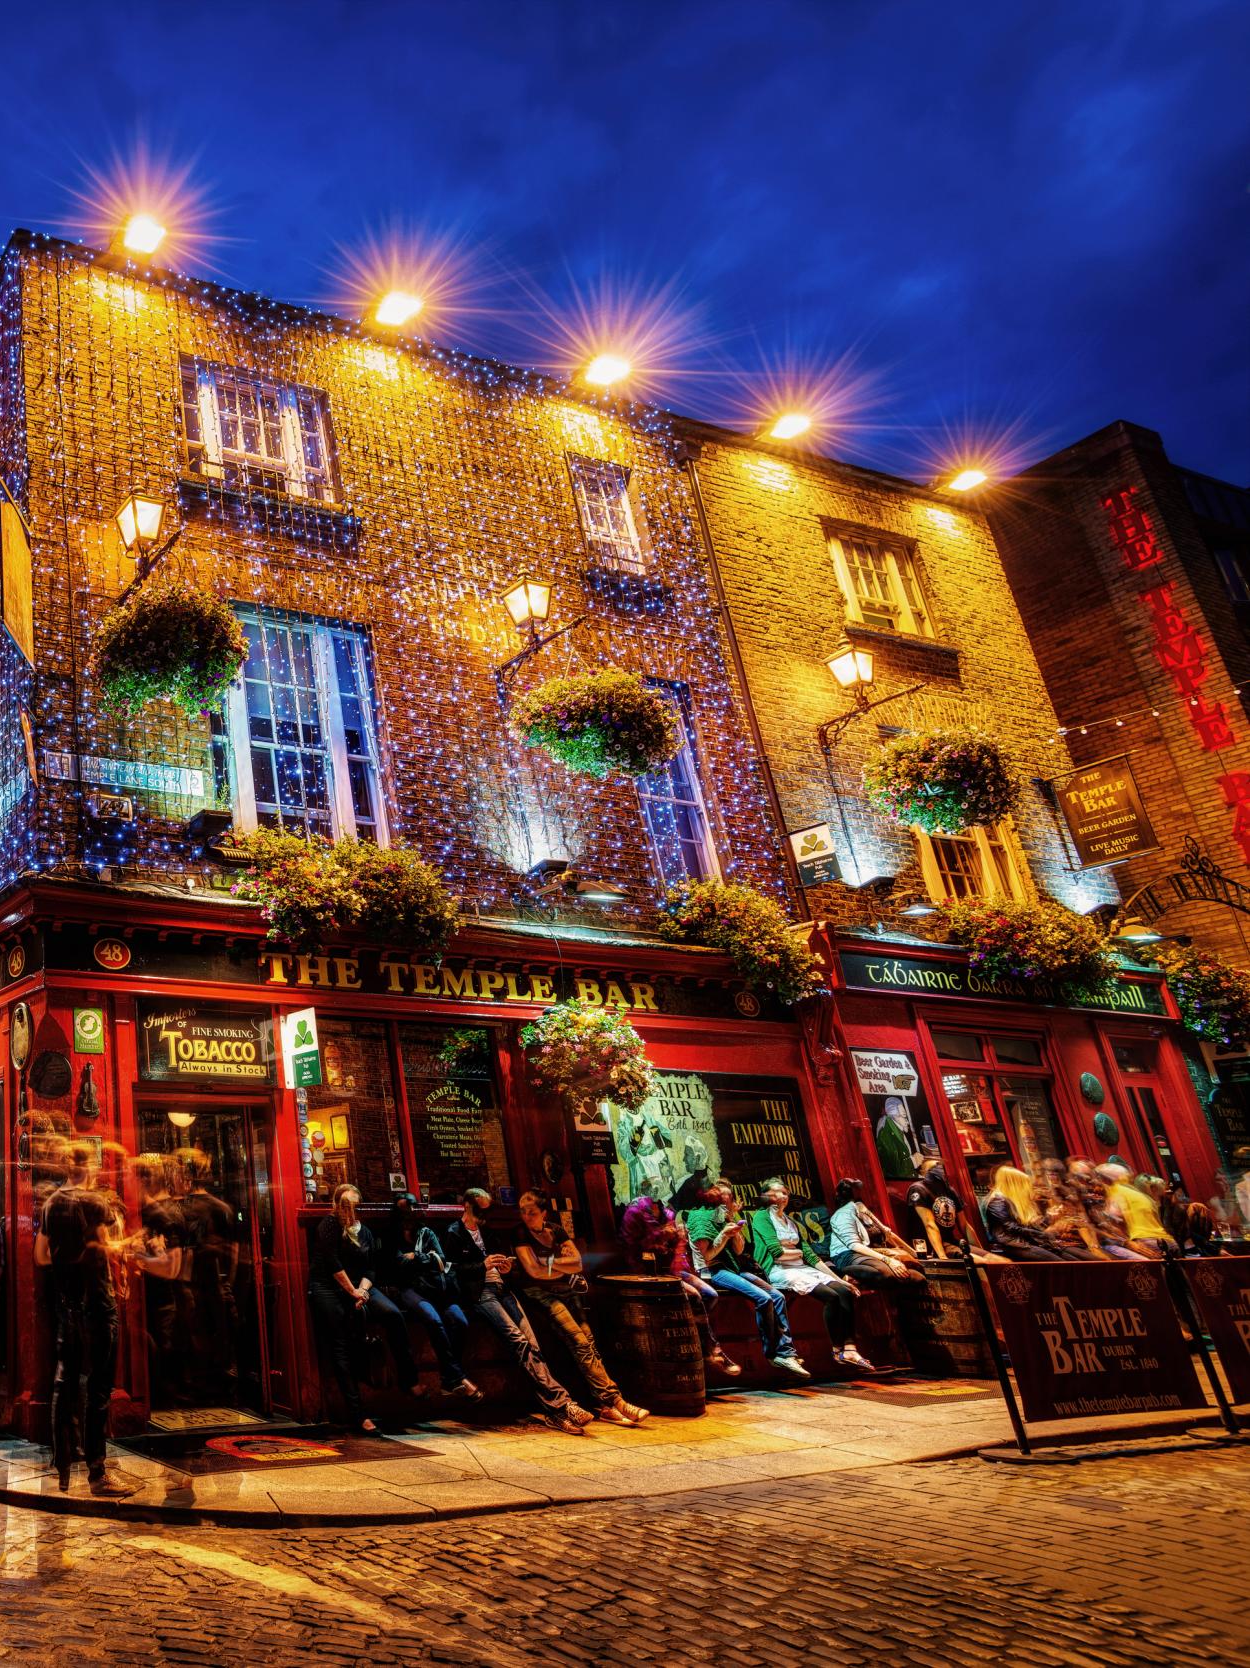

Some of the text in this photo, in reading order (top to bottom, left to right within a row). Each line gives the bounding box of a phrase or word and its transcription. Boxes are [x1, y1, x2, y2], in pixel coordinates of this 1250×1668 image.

[119, 774, 144, 787] LANE
[1080, 771, 1101, 784] THE
[1066, 780, 1126, 805] TEMPLE
[1083, 796, 1118, 813] BAR
[1078, 813, 1137, 835] BEER GARDEN
[1090, 834, 1139, 852] LIVE MUSIC
[1104, 844, 1129, 855] DAILY
[10, 951, 22, 972] 48
[100, 943, 124, 962] 48
[261, 952, 660, 1010] THE TEMPLE BAR
[143, 1008, 197, 1030] Importers
[192, 1027, 254, 1038] FINE SMOKING
[159, 1030, 256, 1068] TOBACCO
[181, 1062, 265, 1075] Always in Stock
[854, 1054, 873, 1067] Beer
[874, 1056, 904, 1069] Garden
[858, 1067, 892, 1083] Smoking
[426, 1086, 482, 1107] TEMPLE BAR
[650, 1082, 708, 1100] MPLE
[868, 1081, 888, 1093] Area
[658, 1100, 696, 1119] BAR
[761, 1099, 792, 1121] THE
[731, 1122, 798, 1147] EMPEROR
[784, 1150, 801, 1172] OF
[1034, 1296, 1147, 1340] THE TEMPLE
[1040, 1330, 1136, 1375] BAR DUBLIN
[1120, 1359, 1138, 1370] Est.
